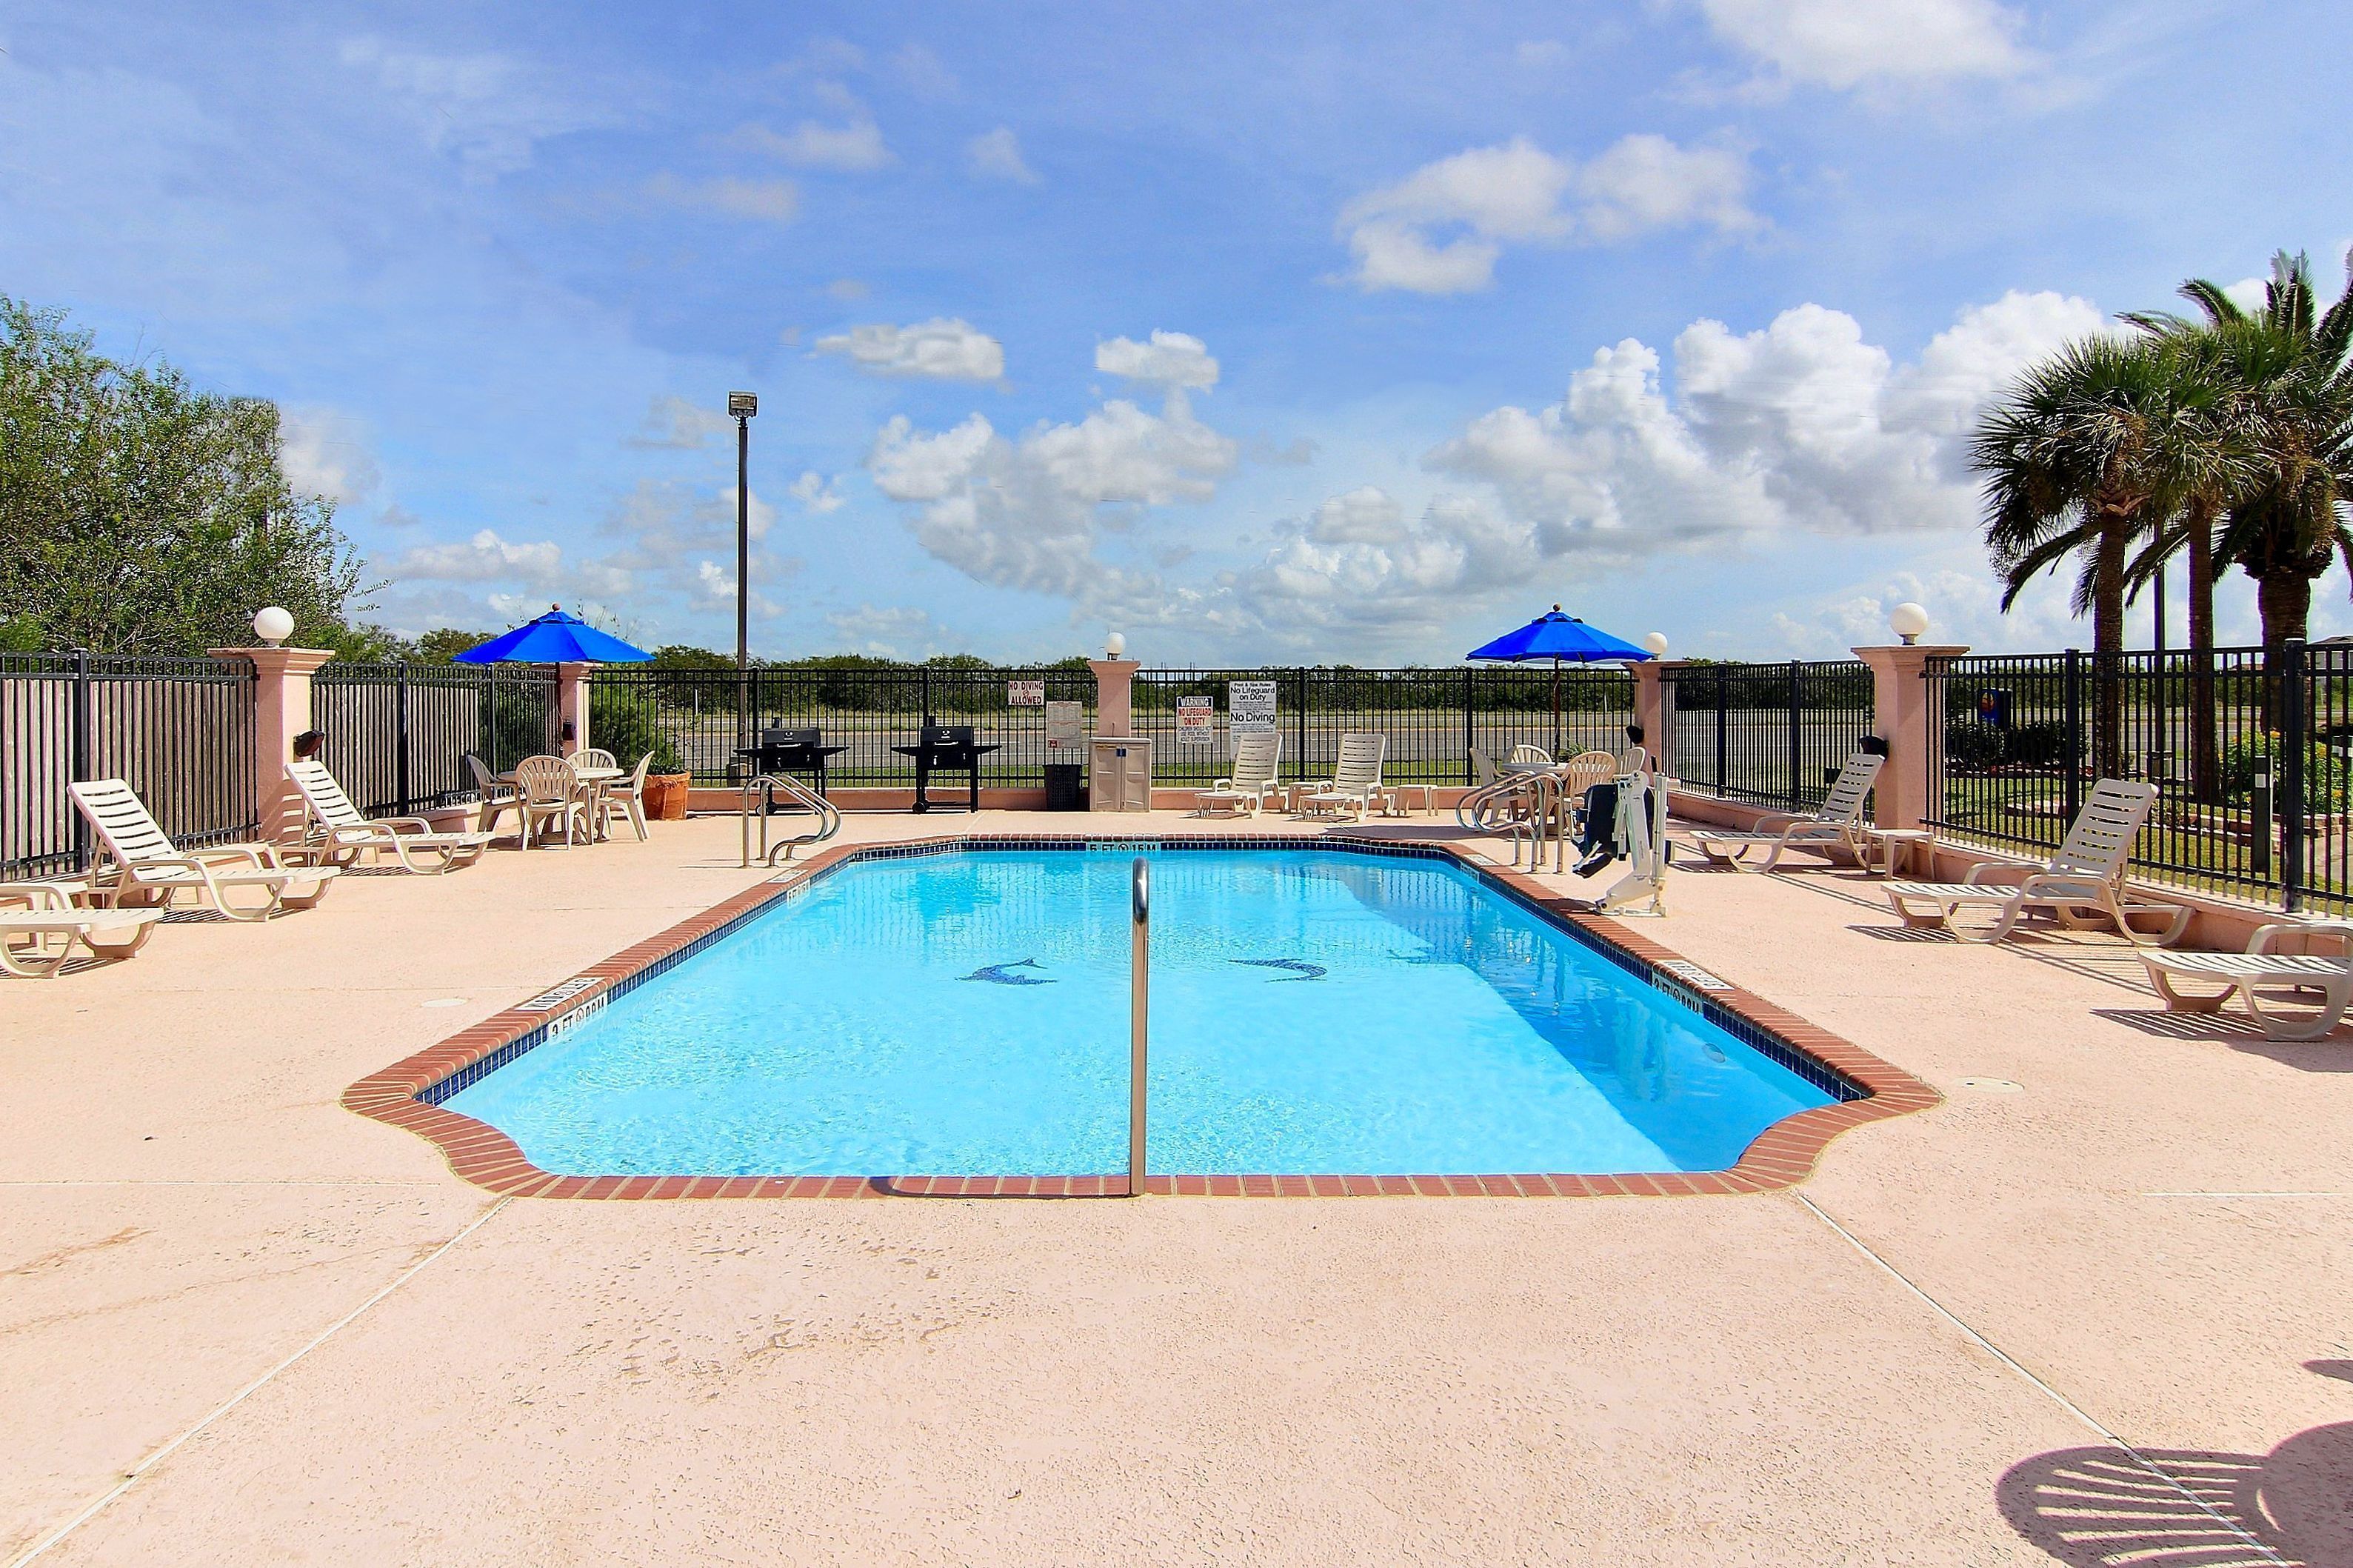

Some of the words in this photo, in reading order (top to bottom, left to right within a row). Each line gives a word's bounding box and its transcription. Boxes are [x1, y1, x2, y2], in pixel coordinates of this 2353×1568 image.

[1009, 681, 1018, 690] NO
[1021, 681, 1044, 690] DIVING
[1242, 687, 1275, 695] Lifeguard
[1011, 695, 1042, 704] ALLOWED
[1181, 698, 1209, 707] WARNING
[1178, 708, 1185, 716] NO
[1186, 708, 1212, 716] LIFEGUARD
[1184, 717, 1192, 725] ON
[1192, 717, 1205, 725] DUTY
[1230, 713, 1244, 722] No
[1246, 712, 1275, 724] Diving
